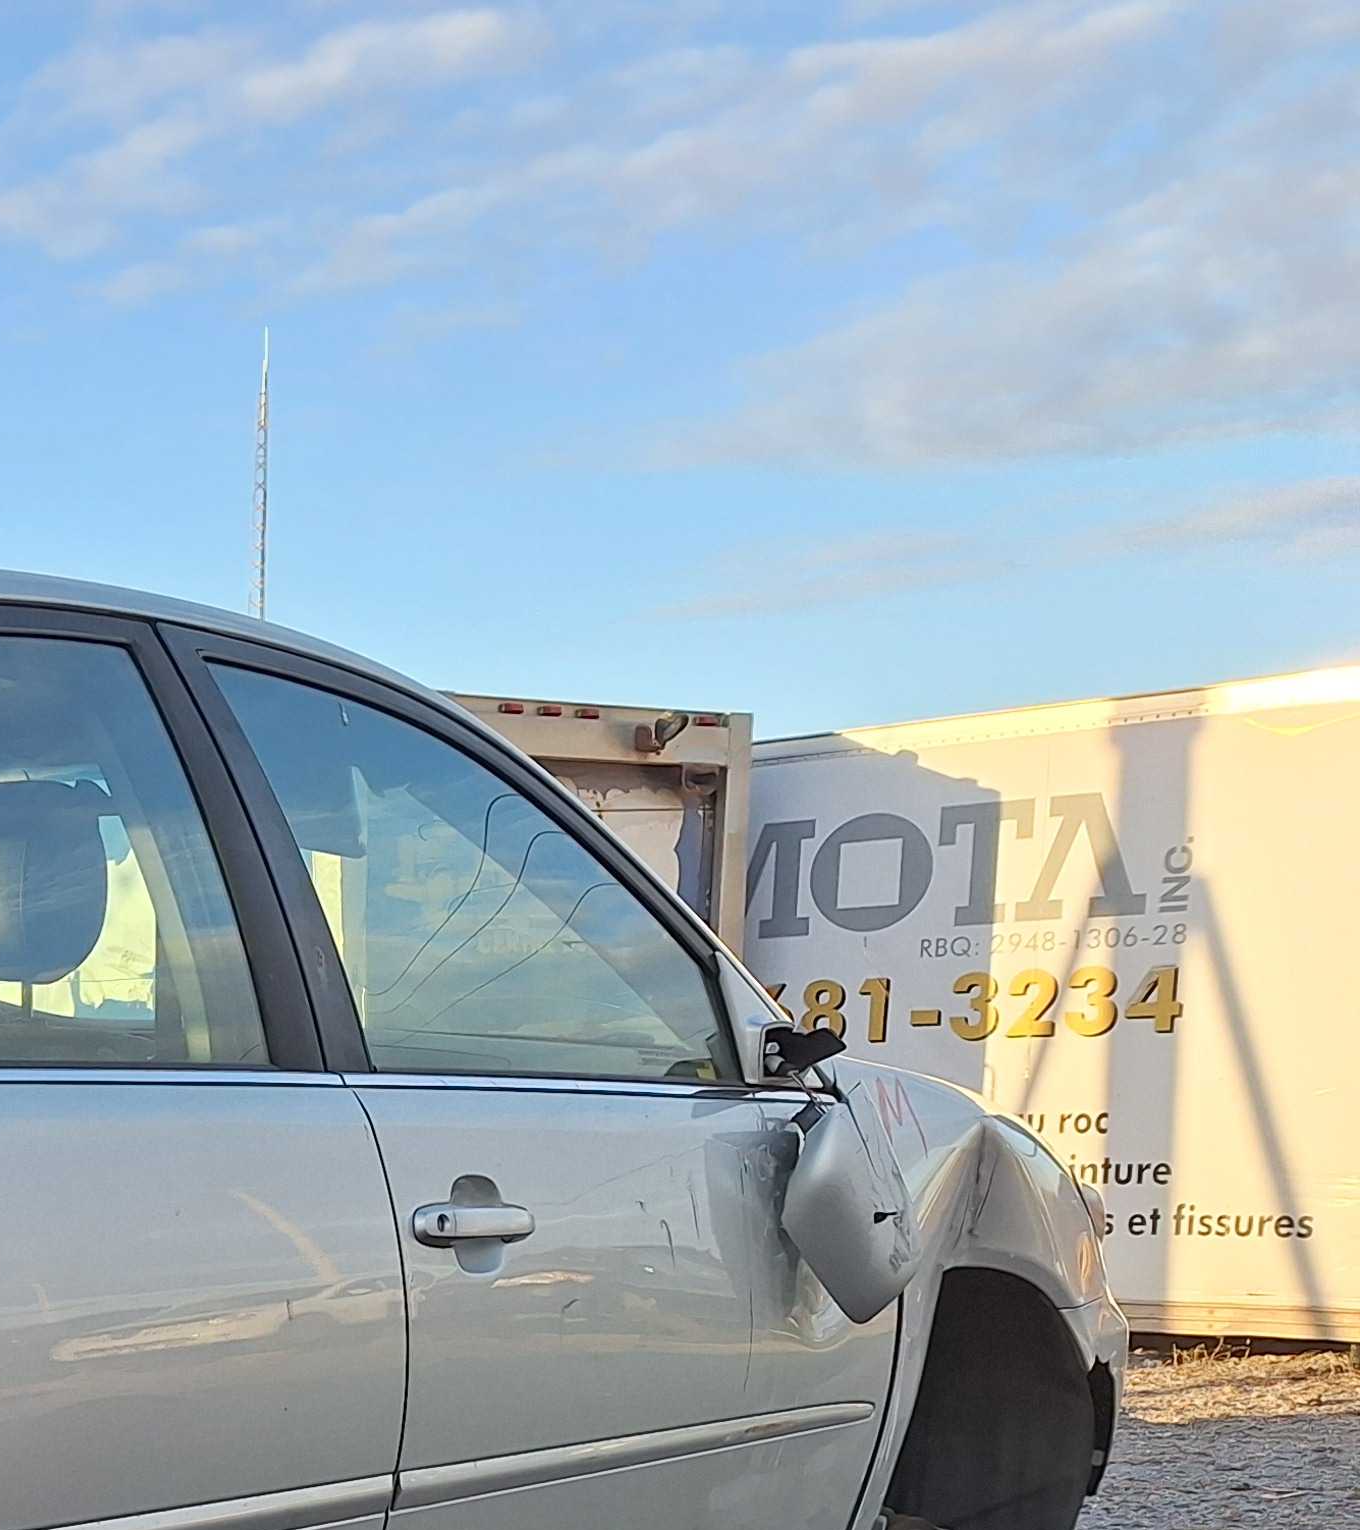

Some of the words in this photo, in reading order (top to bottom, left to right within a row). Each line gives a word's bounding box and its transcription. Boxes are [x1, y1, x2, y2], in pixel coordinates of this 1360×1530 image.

[1157, 835, 1194, 913] INC.
[919, 935, 980, 959] RBQ:
[991, 922, 1188, 955] 2948-1306-28
[766, 964, 1184, 1043] 81-3234
[876, 1077, 928, 1159] M
[1058, 1112, 1109, 1134] roc
[1128, 1208, 1160, 1236] et
[1172, 1203, 1313, 1238] fissures
